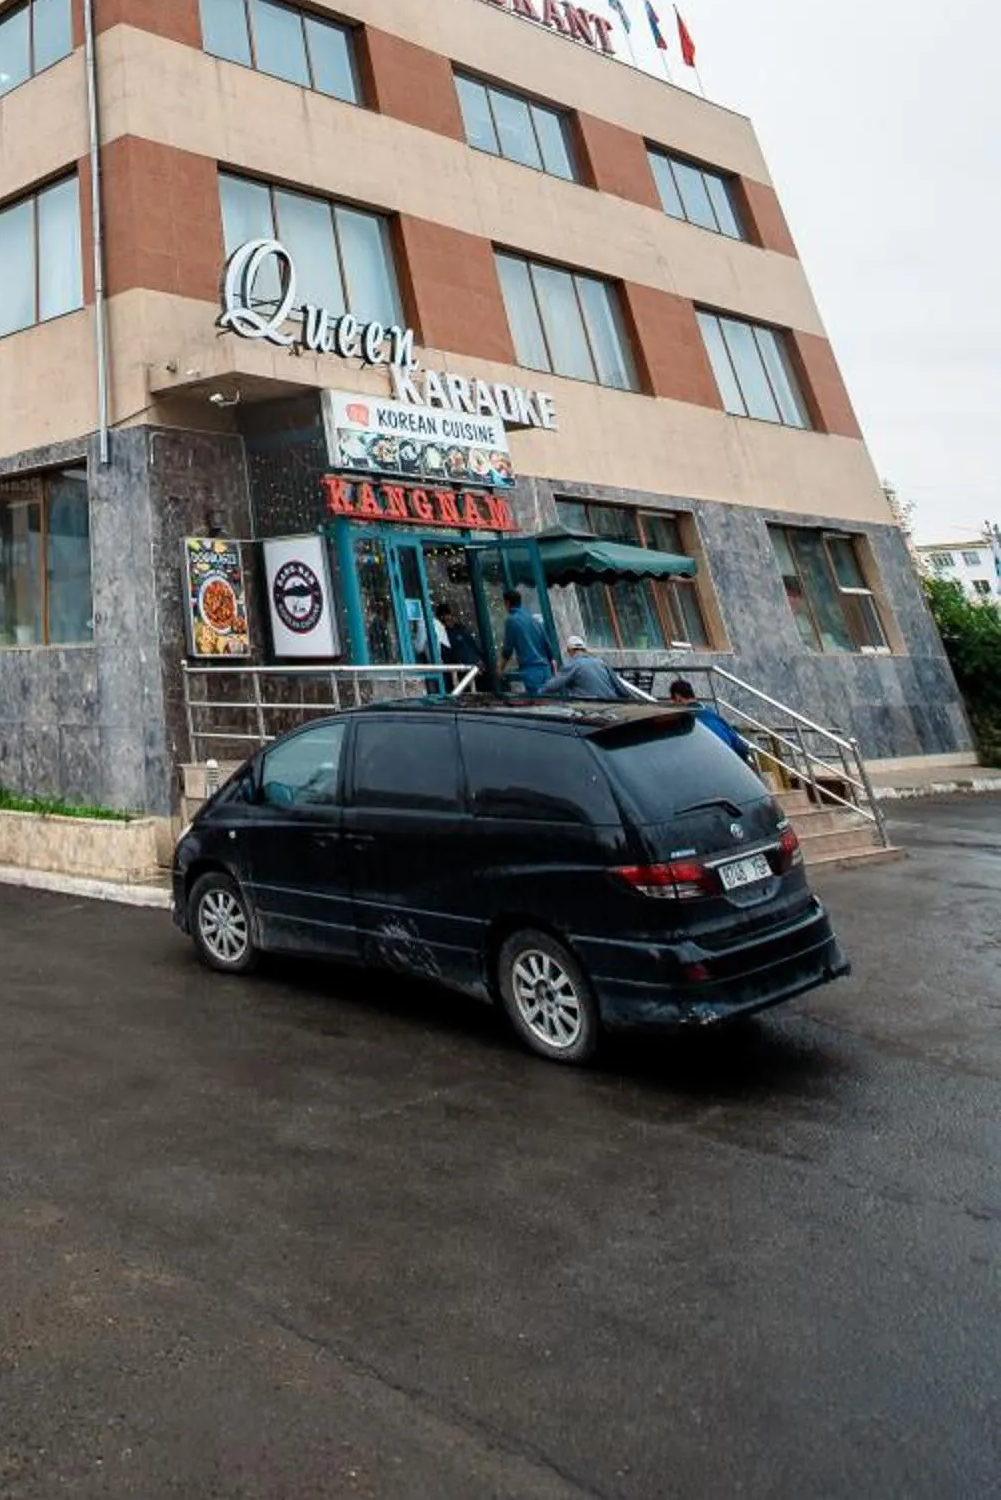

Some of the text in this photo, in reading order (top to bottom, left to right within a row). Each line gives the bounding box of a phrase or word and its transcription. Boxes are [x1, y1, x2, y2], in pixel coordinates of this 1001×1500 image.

[220, 239, 420, 373] Queen
[375, 407, 496, 444] KOREAN CUISINE
[390, 362, 557, 430] KARAOKE
[321, 475, 516, 531] KANGNAM
